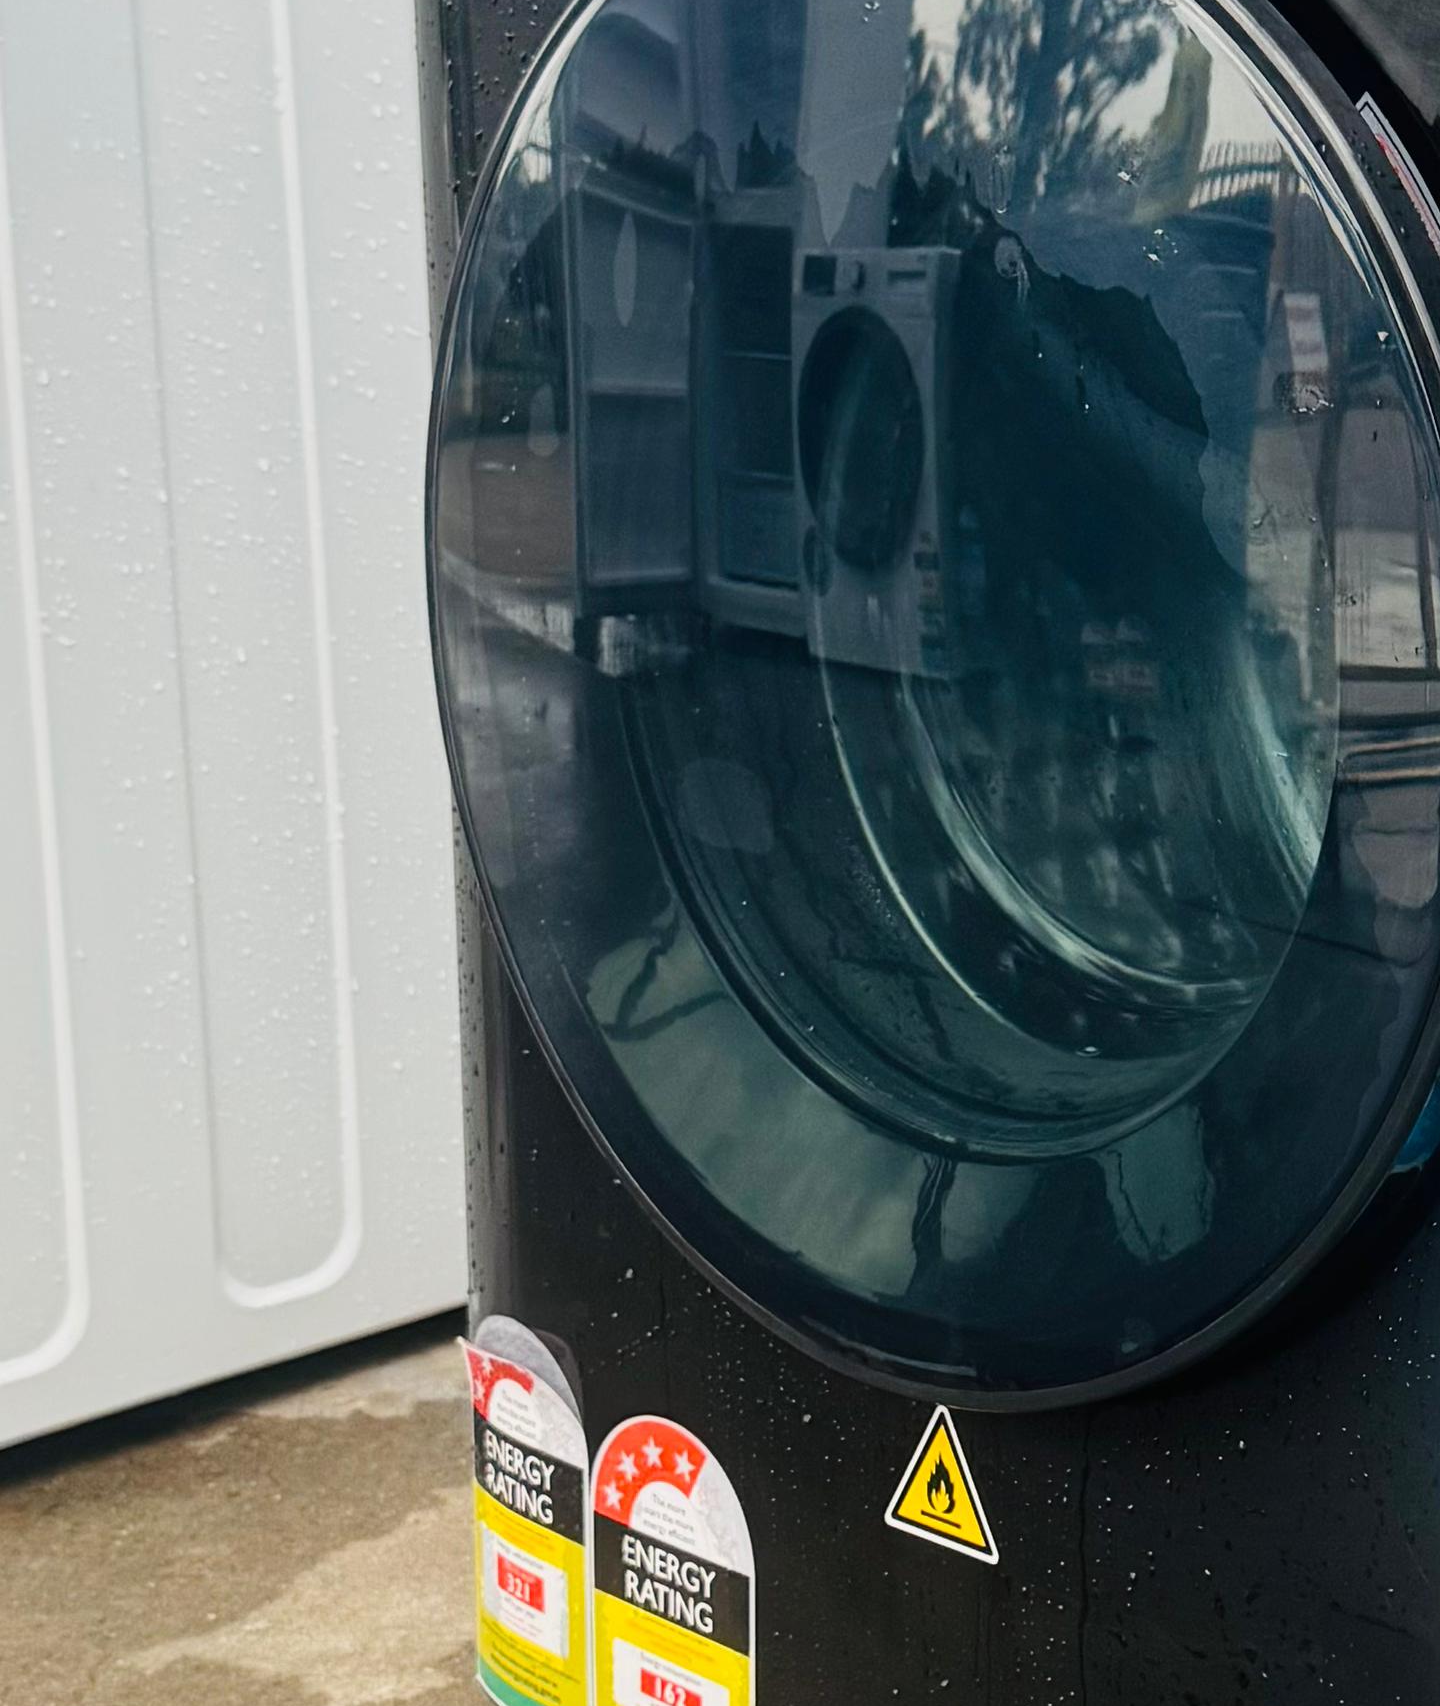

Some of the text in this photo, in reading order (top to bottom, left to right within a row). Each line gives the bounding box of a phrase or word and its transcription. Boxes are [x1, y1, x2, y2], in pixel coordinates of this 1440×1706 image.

[484, 1429, 556, 1493] ENERGY
[484, 1462, 554, 1526] RATING
[620, 1534, 716, 1599] ENERGY
[623, 1569, 715, 1634] RATING
